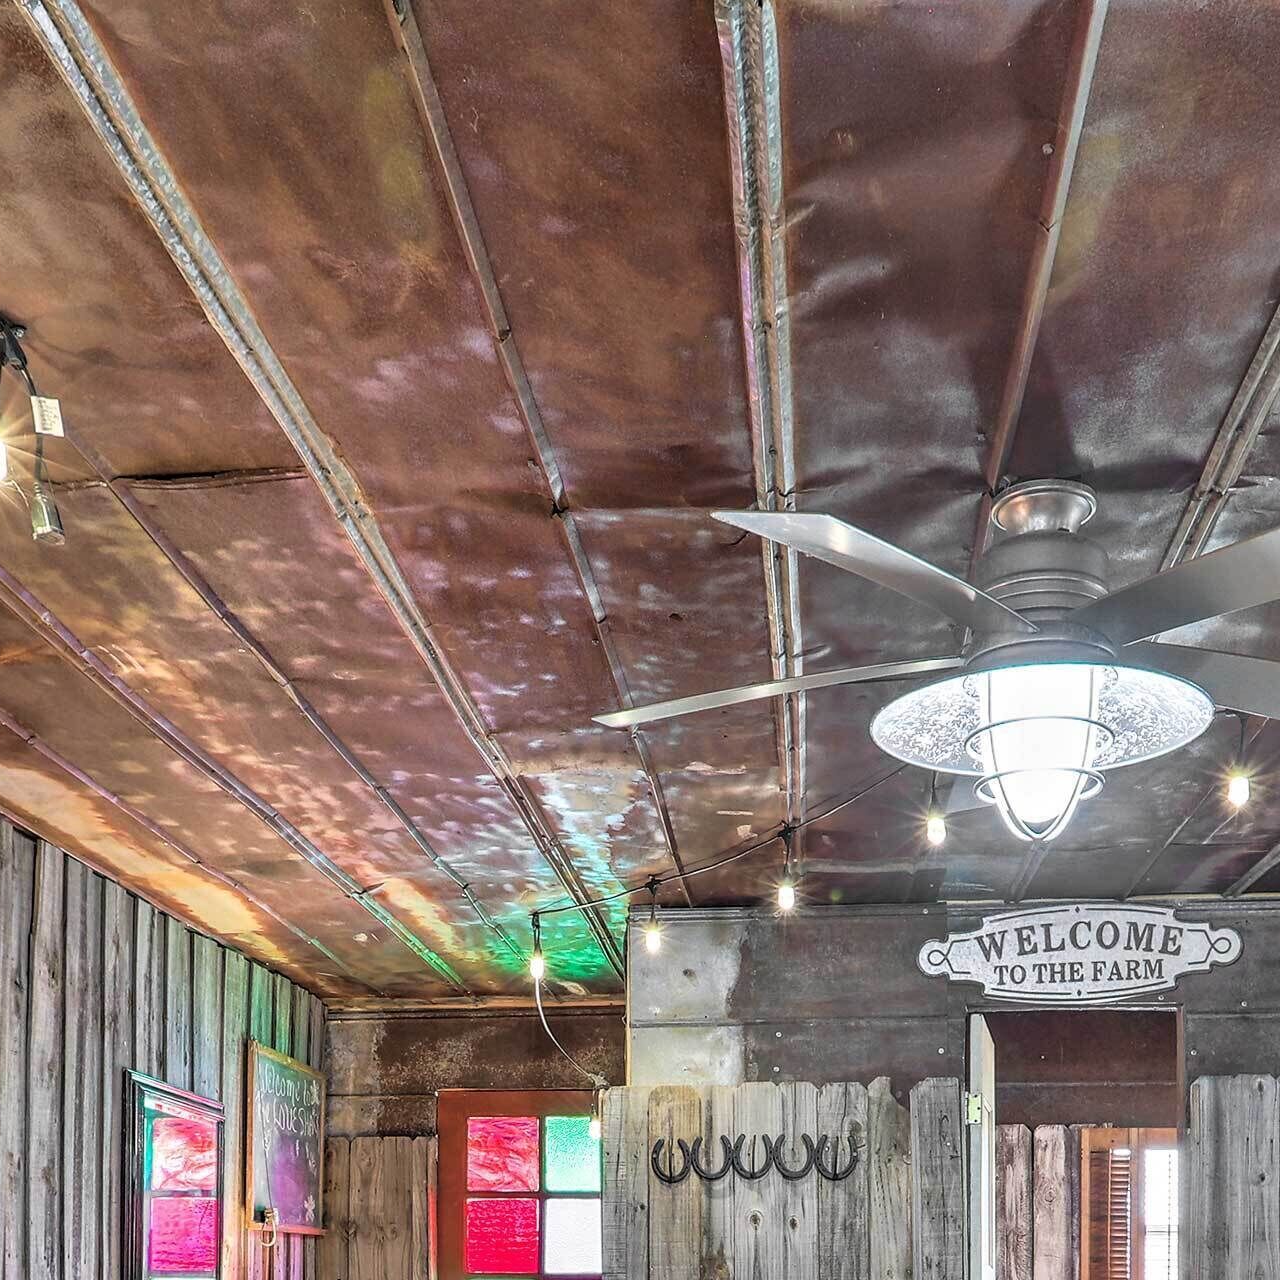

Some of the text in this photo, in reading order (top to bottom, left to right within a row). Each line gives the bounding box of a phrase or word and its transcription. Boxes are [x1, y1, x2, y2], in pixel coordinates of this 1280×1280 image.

[974, 920, 1184, 962] WELCOME
[993, 958, 1164, 985] TO THE FARM
